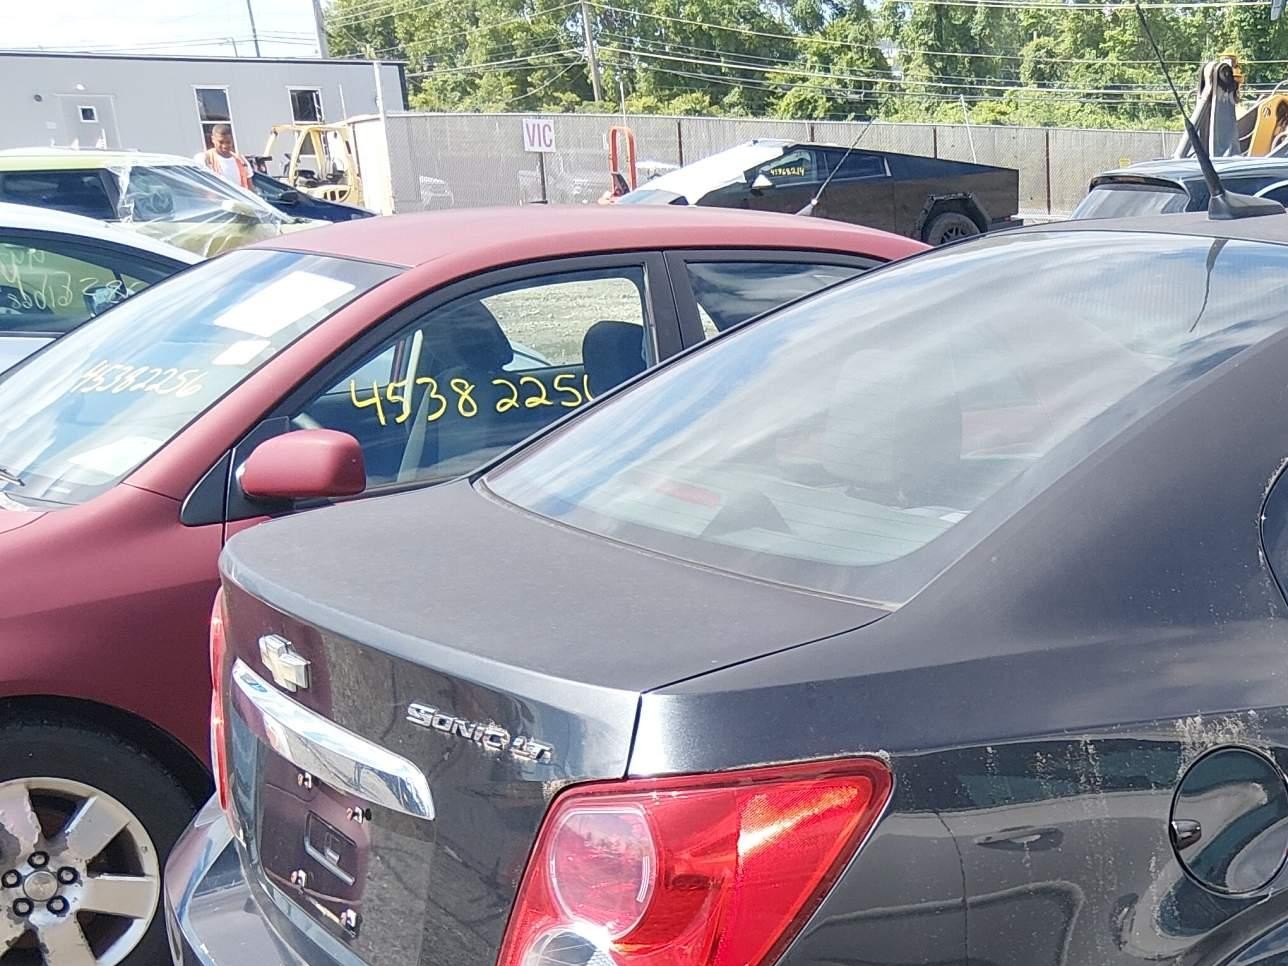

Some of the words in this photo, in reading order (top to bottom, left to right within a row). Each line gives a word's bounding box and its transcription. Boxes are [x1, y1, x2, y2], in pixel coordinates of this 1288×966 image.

[526, 123, 553, 148] VIC
[406, 703, 511, 751] SONIC
[511, 735, 554, 764] LT
